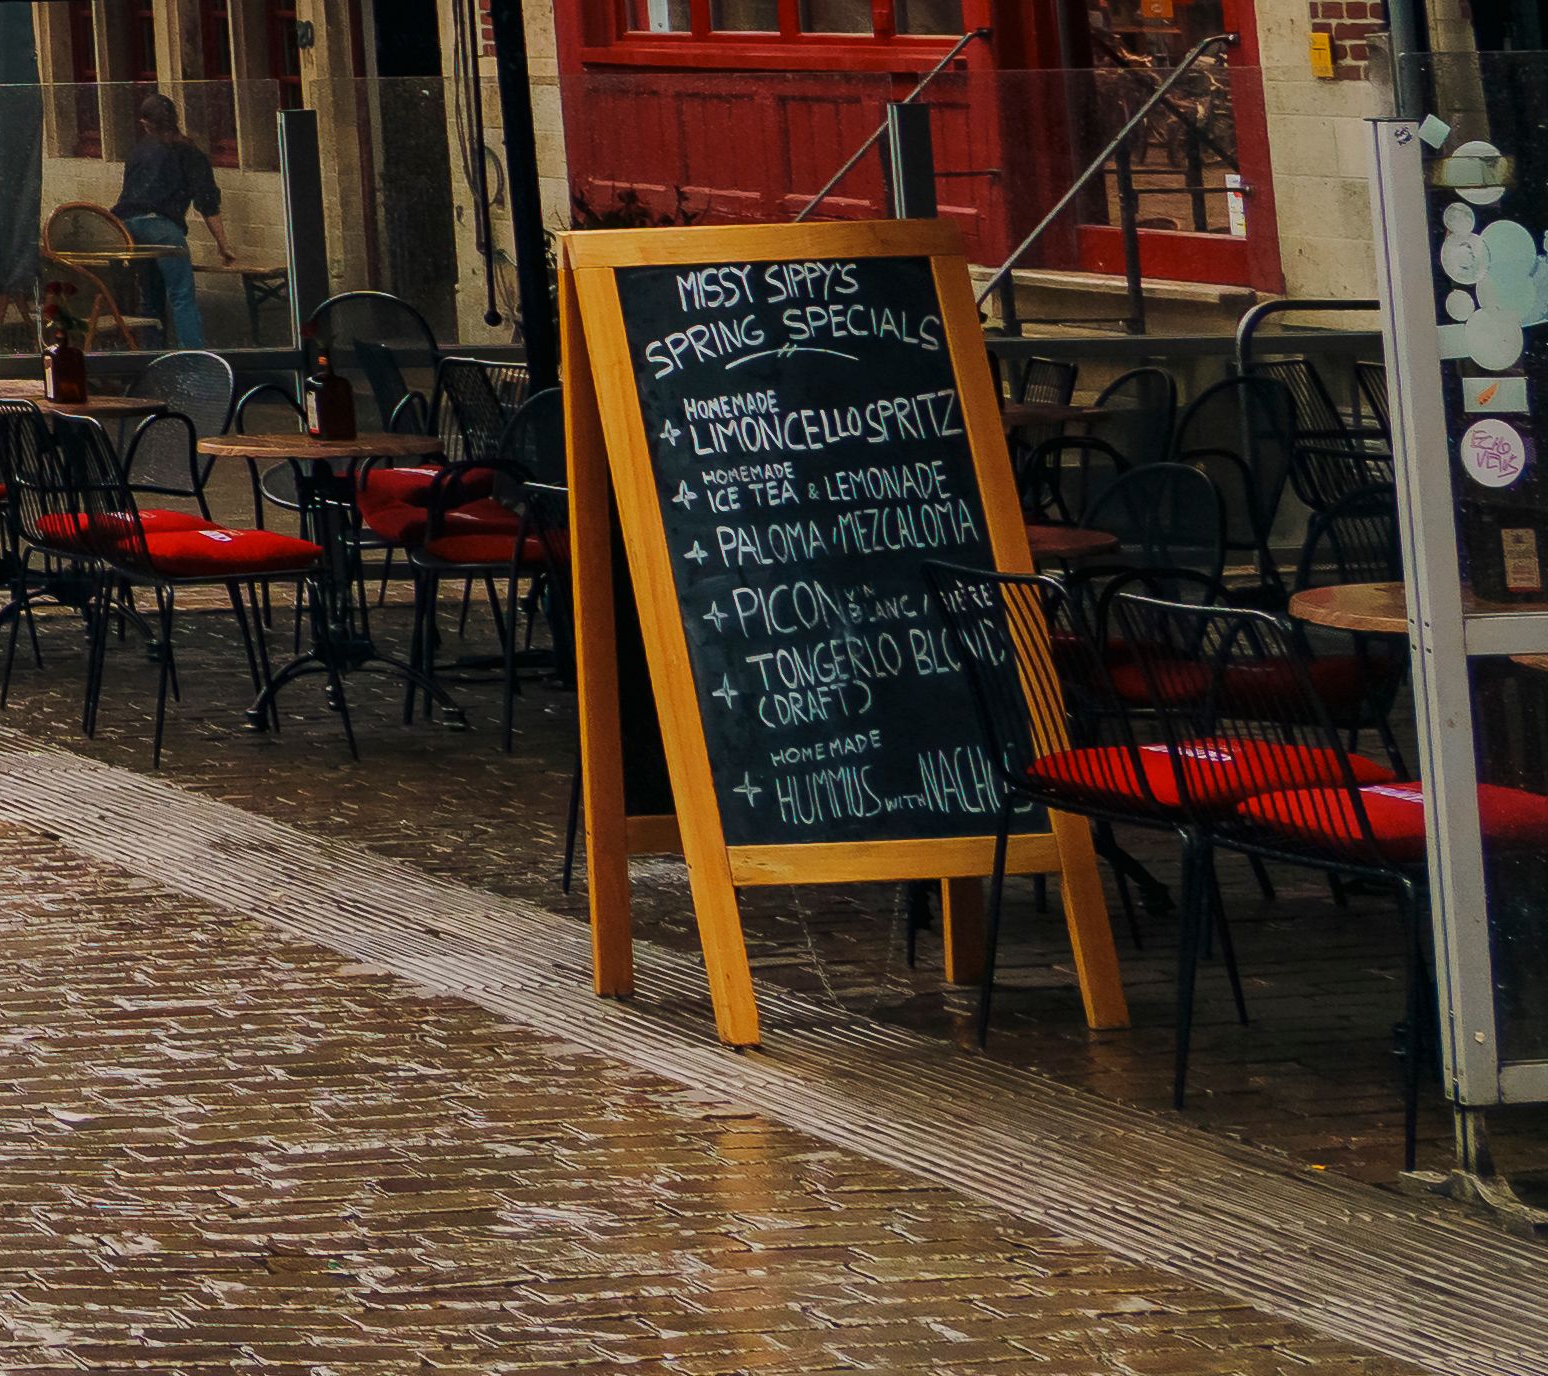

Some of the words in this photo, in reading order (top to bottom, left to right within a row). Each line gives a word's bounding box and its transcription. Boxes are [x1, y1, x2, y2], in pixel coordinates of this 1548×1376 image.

[676, 265, 754, 312] MISSY
[764, 262, 858, 303] SIPPY'S
[645, 314, 765, 379] SPRING
[782, 304, 941, 350] SPECIALS
[683, 389, 780, 421] HOMEMADE
[689, 406, 862, 456] LIMONCELLO
[865, 388, 963, 443] SPRITZ
[702, 461, 796, 484] HOMEMADE
[706, 487, 741, 514] ICE
[747, 480, 800, 507] TEA
[823, 460, 952, 502] LEMONADE
[715, 519, 830, 568] PALOMA
[838, 498, 980, 555] MEZCALOMA
[732, 580, 849, 638] PICON
[746, 631, 902, 691] TONGERLO
[758, 680, 872, 729] (DRAFT)
[770, 729, 882, 767] HOMEMADE
[775, 765, 883, 824] HUMMUS
